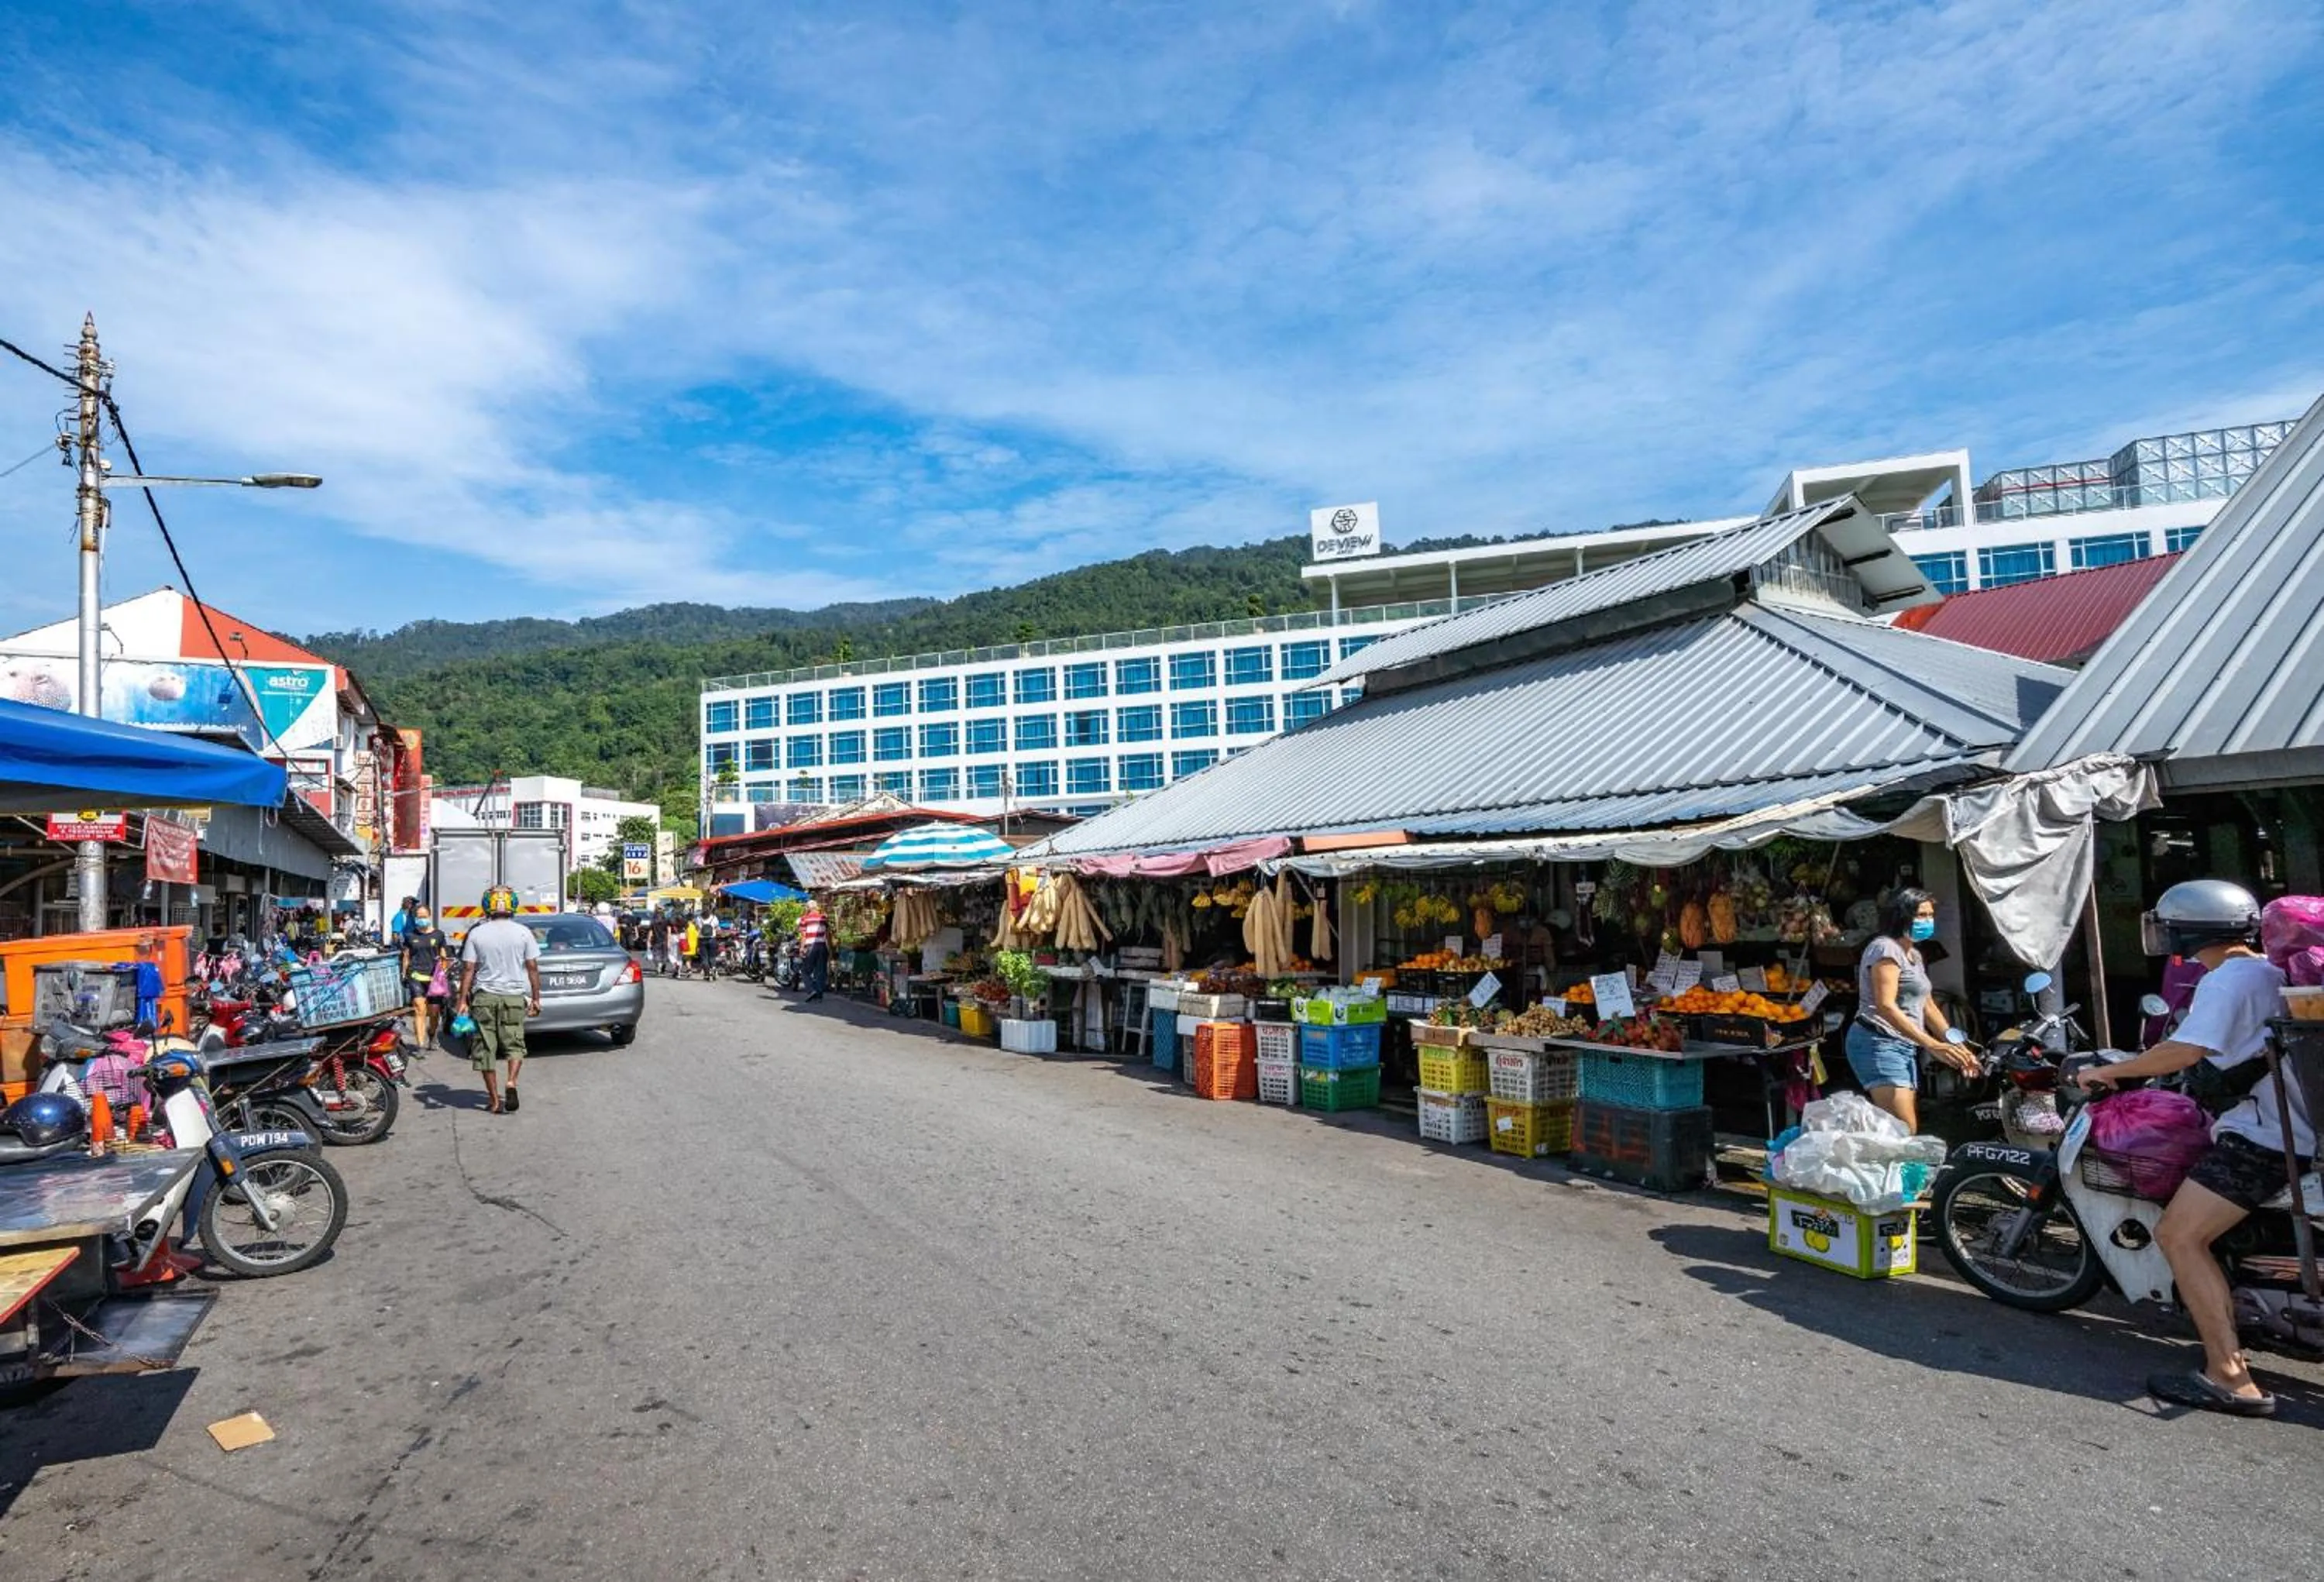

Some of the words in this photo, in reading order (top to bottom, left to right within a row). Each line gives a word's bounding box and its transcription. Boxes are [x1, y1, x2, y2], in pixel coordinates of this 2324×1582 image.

[269, 675, 309, 688] astro
[626, 861, 641, 875] 16
[241, 1134, 266, 1147] PDW
[268, 1132, 288, 1144] 194
[1967, 1145, 2030, 1165] PFG7122
